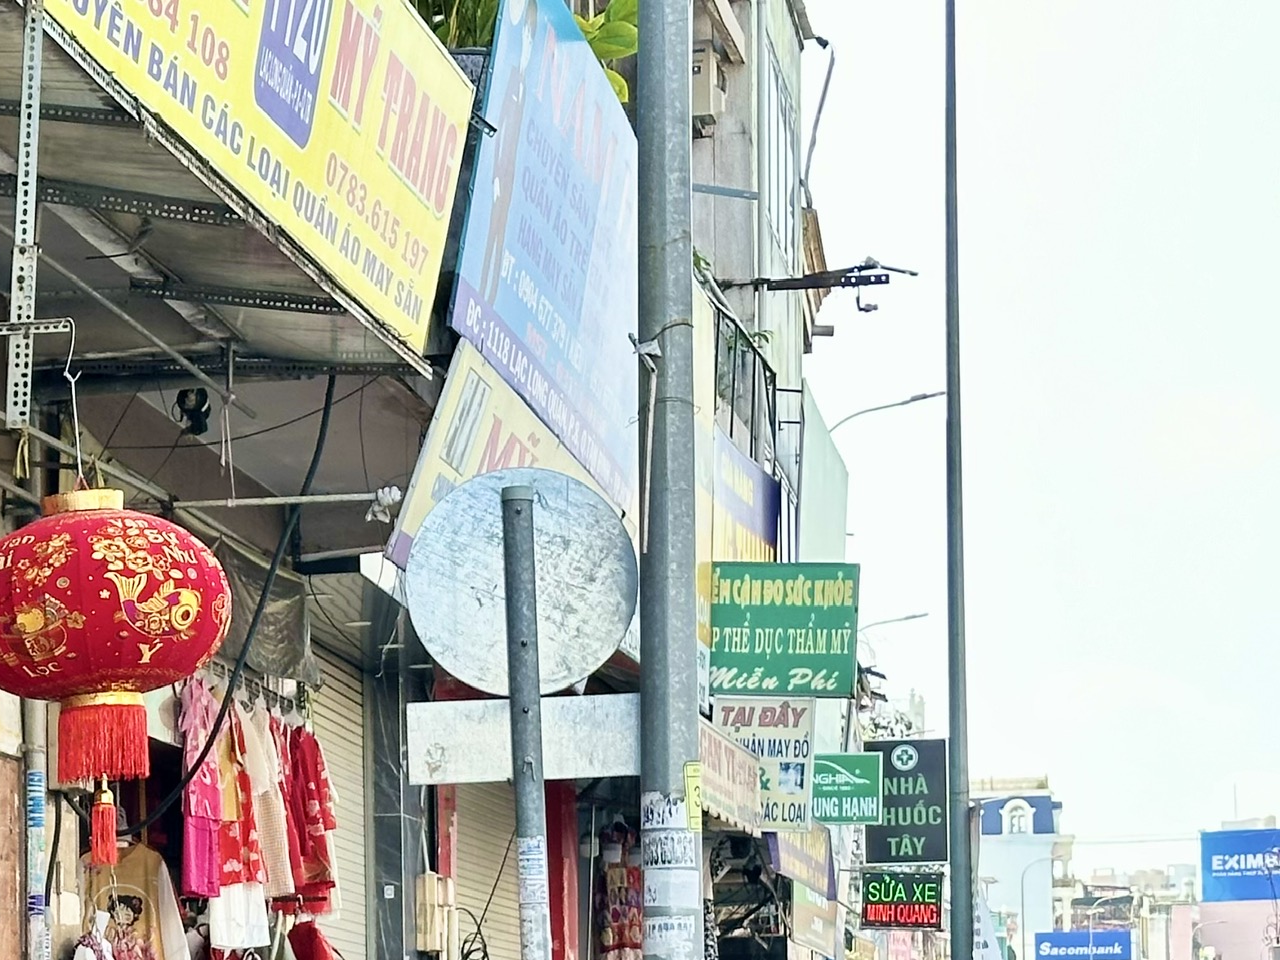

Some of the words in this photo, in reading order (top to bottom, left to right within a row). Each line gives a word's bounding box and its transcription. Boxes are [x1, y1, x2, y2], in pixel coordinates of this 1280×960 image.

[187, 14, 230, 81] 108
[377, 50, 458, 214] TRANG
[147, 42, 198, 114] BÁN
[201, 93, 244, 156] CÁC
[246, 135, 290, 200] LOẠI
[292, 180, 339, 247] QUẦN
[338, 223, 361, 266] ÁO
[361, 247, 394, 298] MAY
[526, 118, 570, 197] CHUYÊN
[326, 152, 400, 250] 0783.615
[401, 230, 429, 276] 197
[552, 206, 568, 246] ÁO
[541, 245, 561, 289] MAY
[486, 321, 511, 365] 1118
[509, 344, 529, 383] LẠC
[527, 365, 549, 408] LONG
[763, 578, 784, 606] ĐO
[785, 574, 813, 606] SỨC
[138, 638, 163, 664] Ý
[723, 612, 750, 653] THỂ
[754, 628, 784, 661] DỤC
[787, 613, 827, 654] THẨM
[709, 665, 779, 691] Miễn
[787, 667, 839, 691] Phí
[721, 706, 755, 733] TẠI
[758, 701, 808, 728] ĐÂY
[767, 739, 791, 758] MAY
[884, 773, 929, 795] NHÀ
[781, 802, 806, 827] LOẠI
[843, 797, 877, 820] HẠNH
[887, 833, 927, 857] TÂY
[868, 875, 907, 902] SỬA
[912, 883, 938, 902] XE
[866, 904, 896, 922] MINH
[897, 904, 938, 924] QUANG
[1039, 941, 1123, 956] Sacombank
